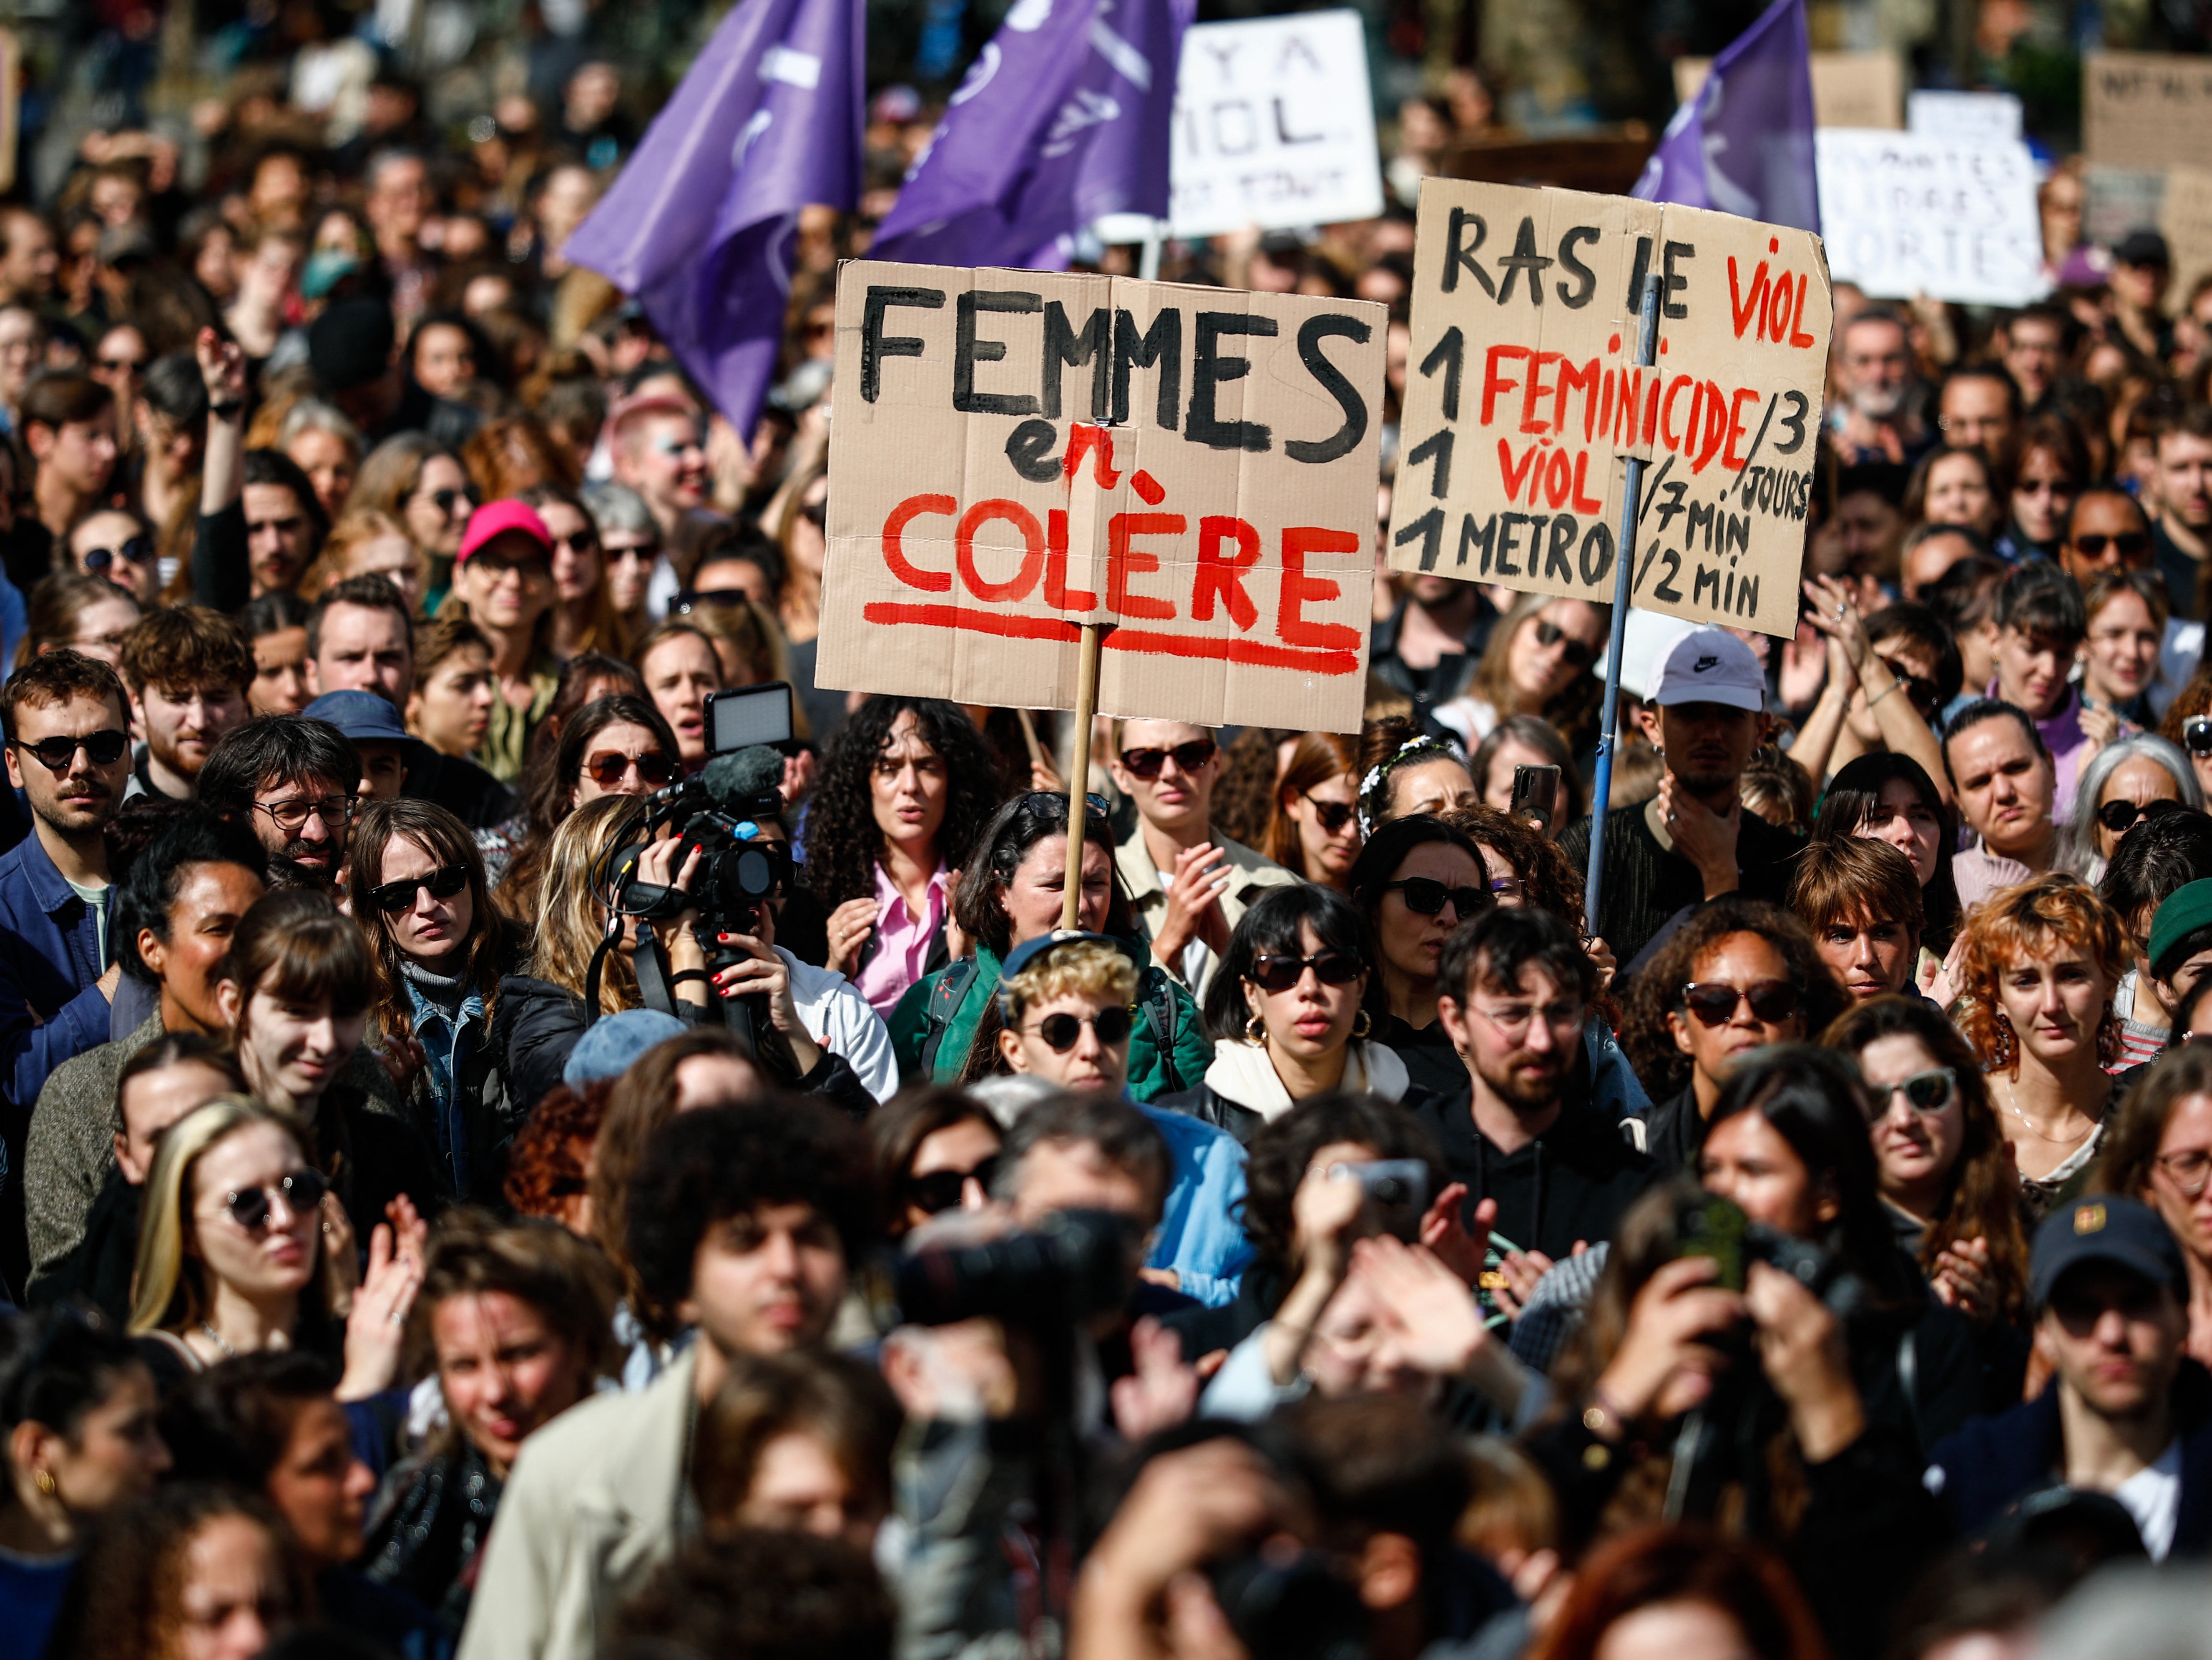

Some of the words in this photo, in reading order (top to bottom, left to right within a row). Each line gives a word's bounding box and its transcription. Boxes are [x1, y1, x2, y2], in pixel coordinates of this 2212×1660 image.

[1184, 93, 1327, 159] IOL
[1440, 207, 1601, 310] RAS
[860, 285, 1372, 464] FEMMES
[1420, 326, 1464, 422] 1
[1005, 419, 1122, 491] en
[1407, 427, 1455, 499] 1
[1741, 466, 1812, 521] JOURS
[881, 469, 1362, 650] COLÈRE
[1395, 505, 1446, 572] 1
[1457, 512, 1615, 586] METRO
